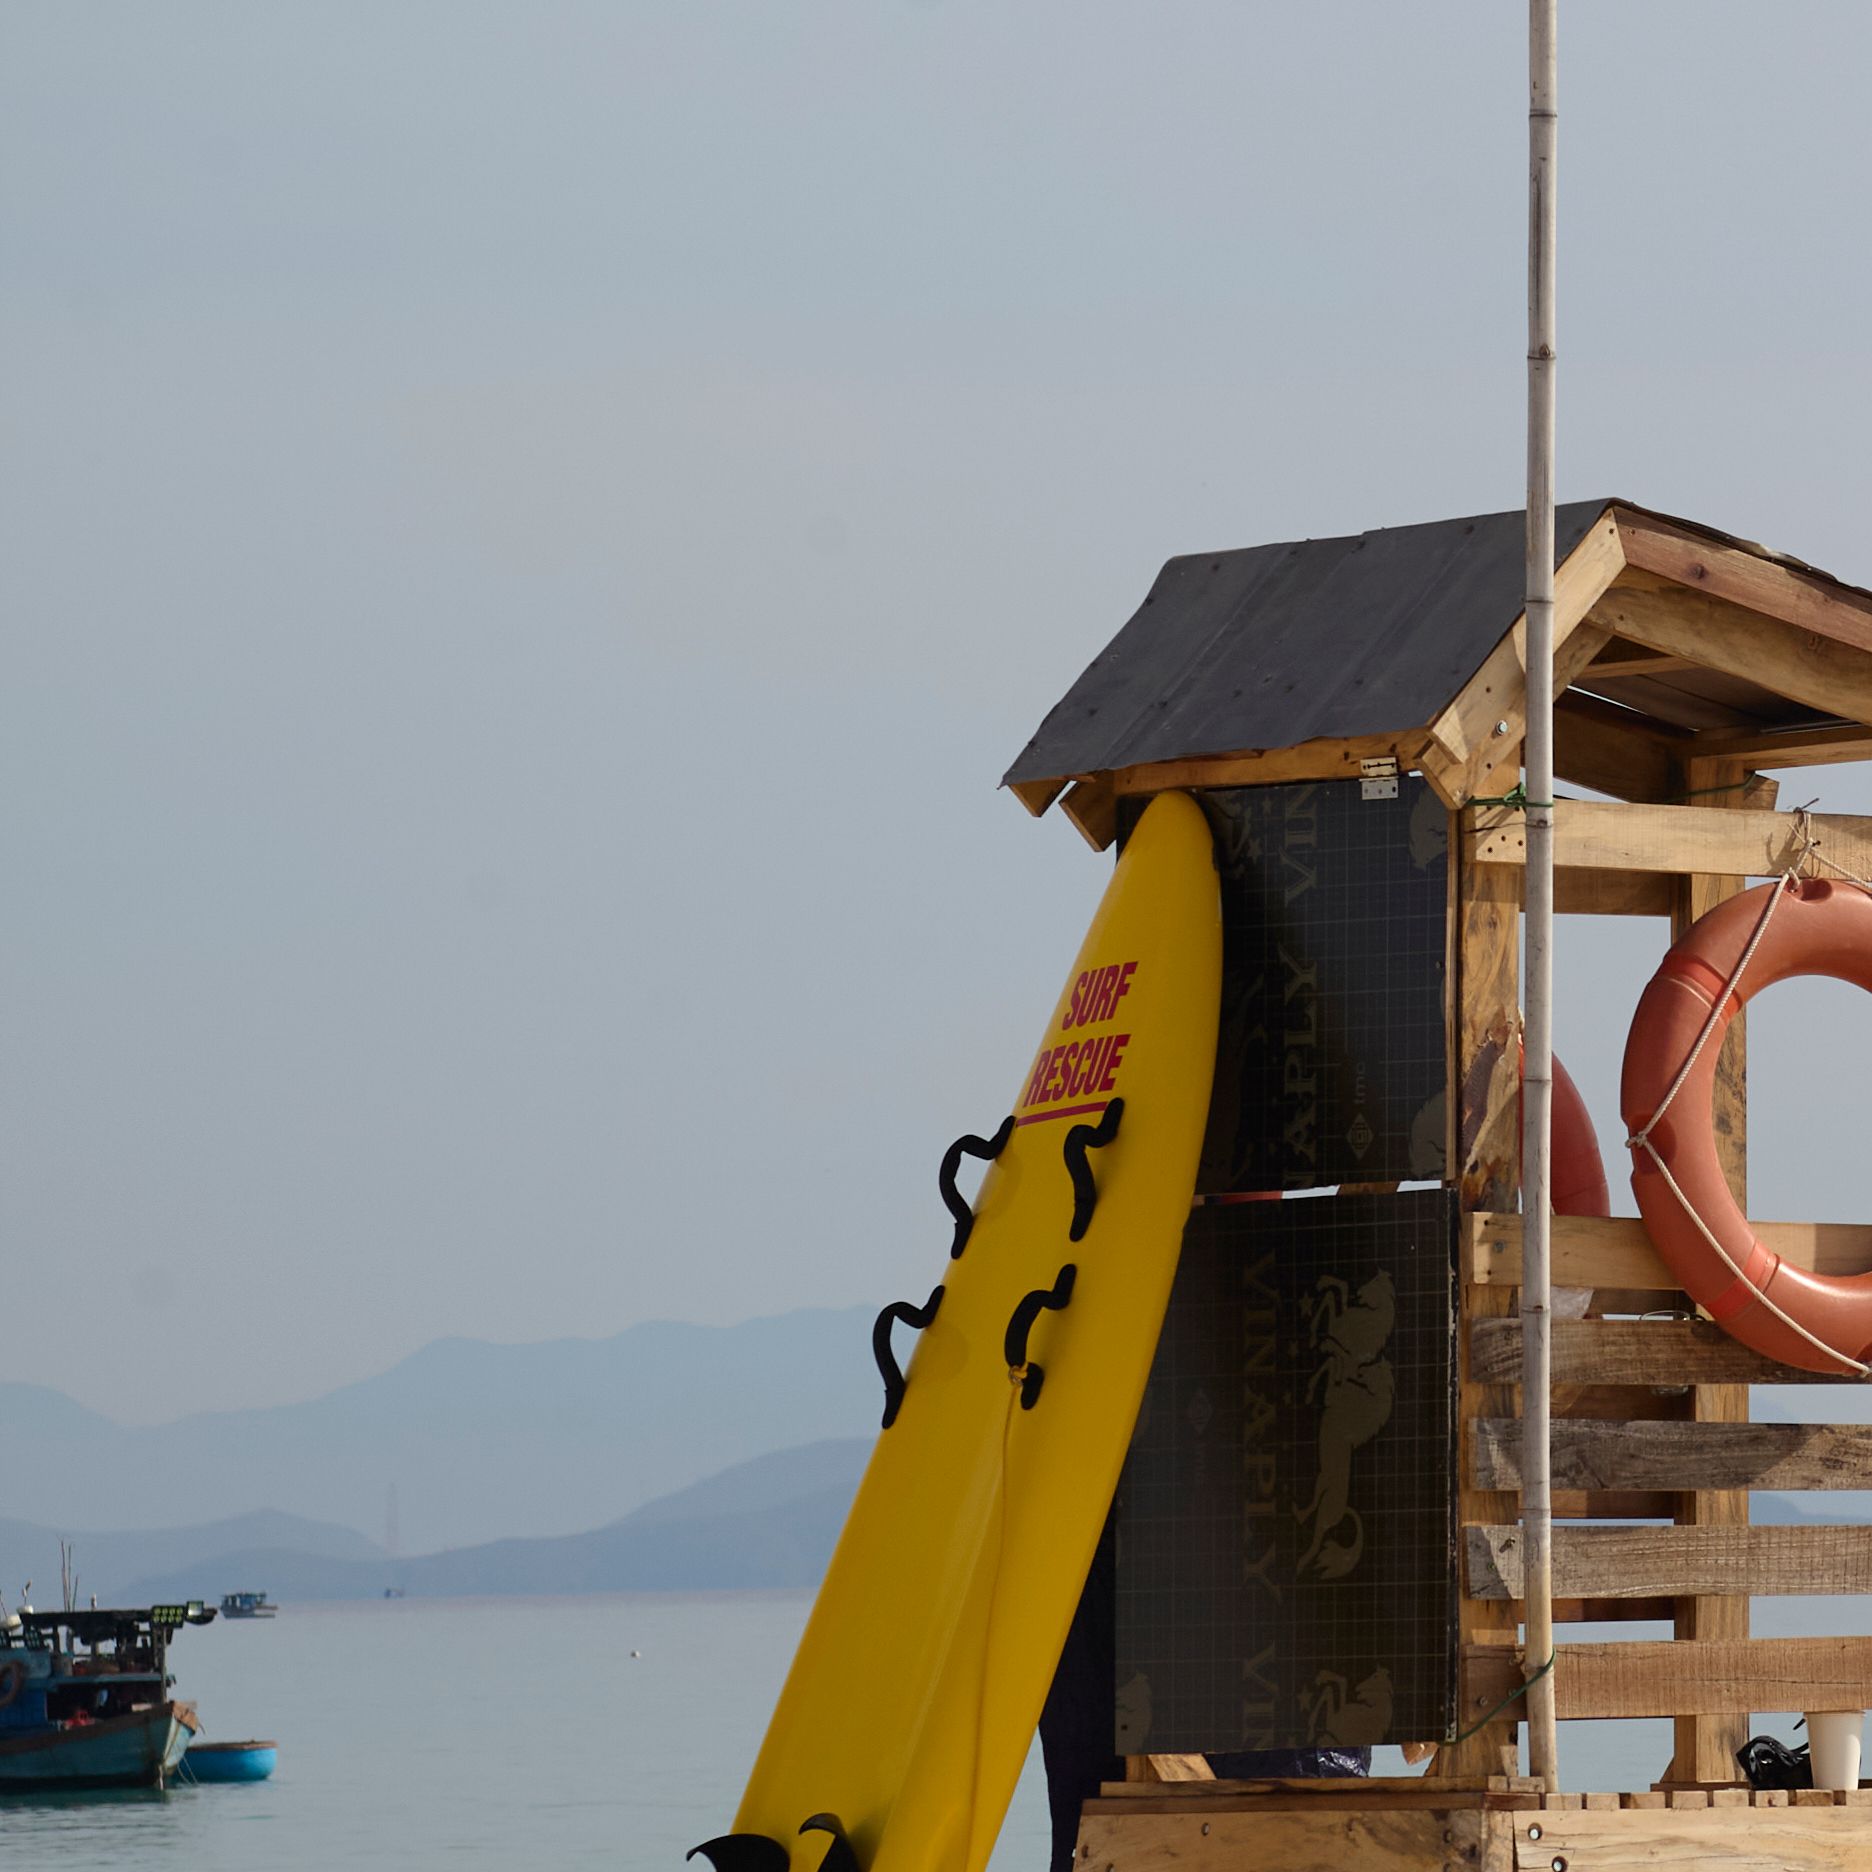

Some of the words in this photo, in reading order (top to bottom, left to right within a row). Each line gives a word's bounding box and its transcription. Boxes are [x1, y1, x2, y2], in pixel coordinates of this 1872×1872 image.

[1062, 961, 1139, 1030] SURF
[1022, 1033, 1132, 1108] RESCUE
[1242, 1248, 1283, 1603] VINAPLY
